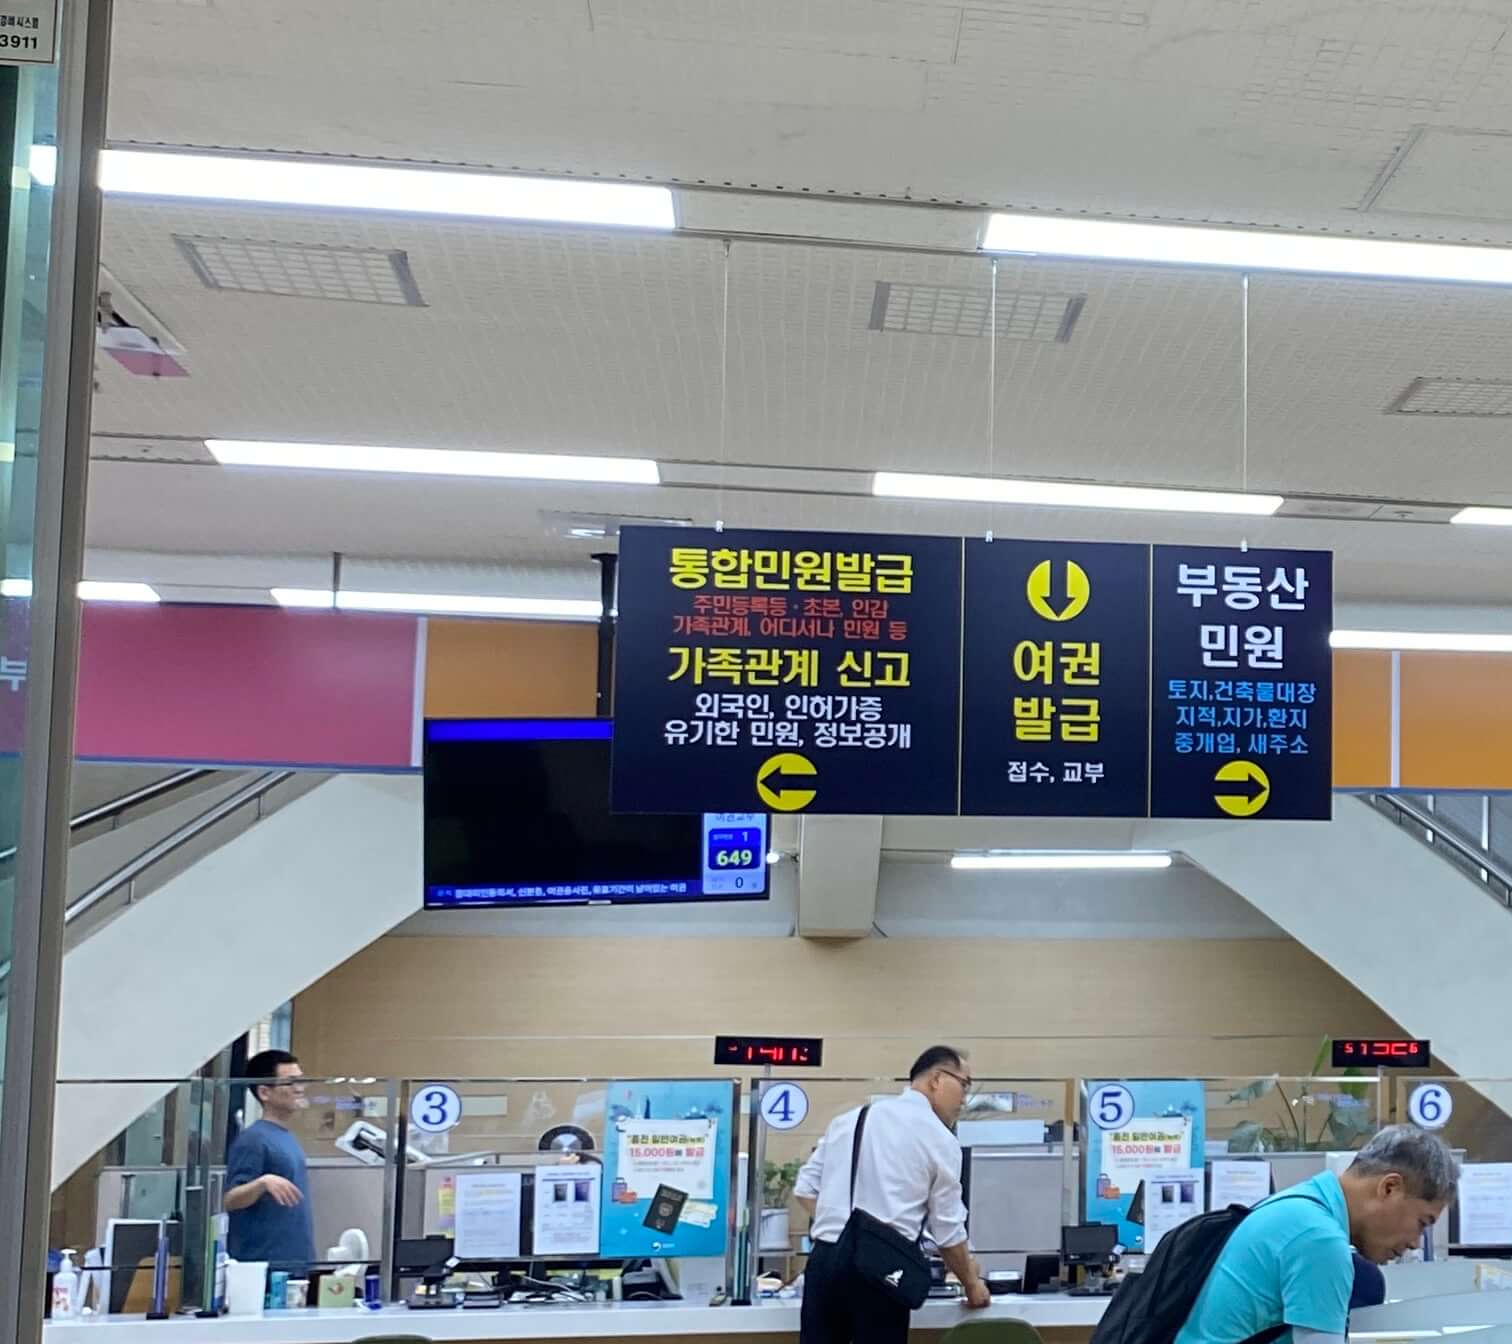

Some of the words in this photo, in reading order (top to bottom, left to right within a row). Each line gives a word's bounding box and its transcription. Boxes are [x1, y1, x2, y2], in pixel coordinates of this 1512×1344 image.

[669, 547, 914, 594] 통합민원발급
[1176, 563, 1309, 611] 부동산
[852, 599, 888, 619] 인감
[760, 616, 835, 639] 어디서나
[843, 619, 880, 640] 민원
[888, 621, 907, 641] 등
[1013, 640, 1100, 685] 여권
[1200, 624, 1284, 669] 민원
[668, 647, 819, 687] 가족관계
[836, 650, 911, 688] 신고
[695, 693, 774, 720] 외국인,
[784, 694, 882, 722] 인허가증
[1013, 697, 1101, 742] 발급
[664, 719, 740, 746] 유기한
[750, 721, 804, 747] 민원,
[814, 722, 911, 749] 정보공개
[1174, 732, 1241, 754] 중개업,
[1248, 733, 1309, 755] 새주소
[1007, 761, 1055, 784] 접수,
[1063, 761, 1105, 784] 교부
[716, 849, 753, 866] 649
[422, 1090, 449, 1126] 3
[768, 1089, 795, 1123] 4
[1098, 1089, 1124, 1124] 5
[1419, 1088, 1442, 1122] 6
